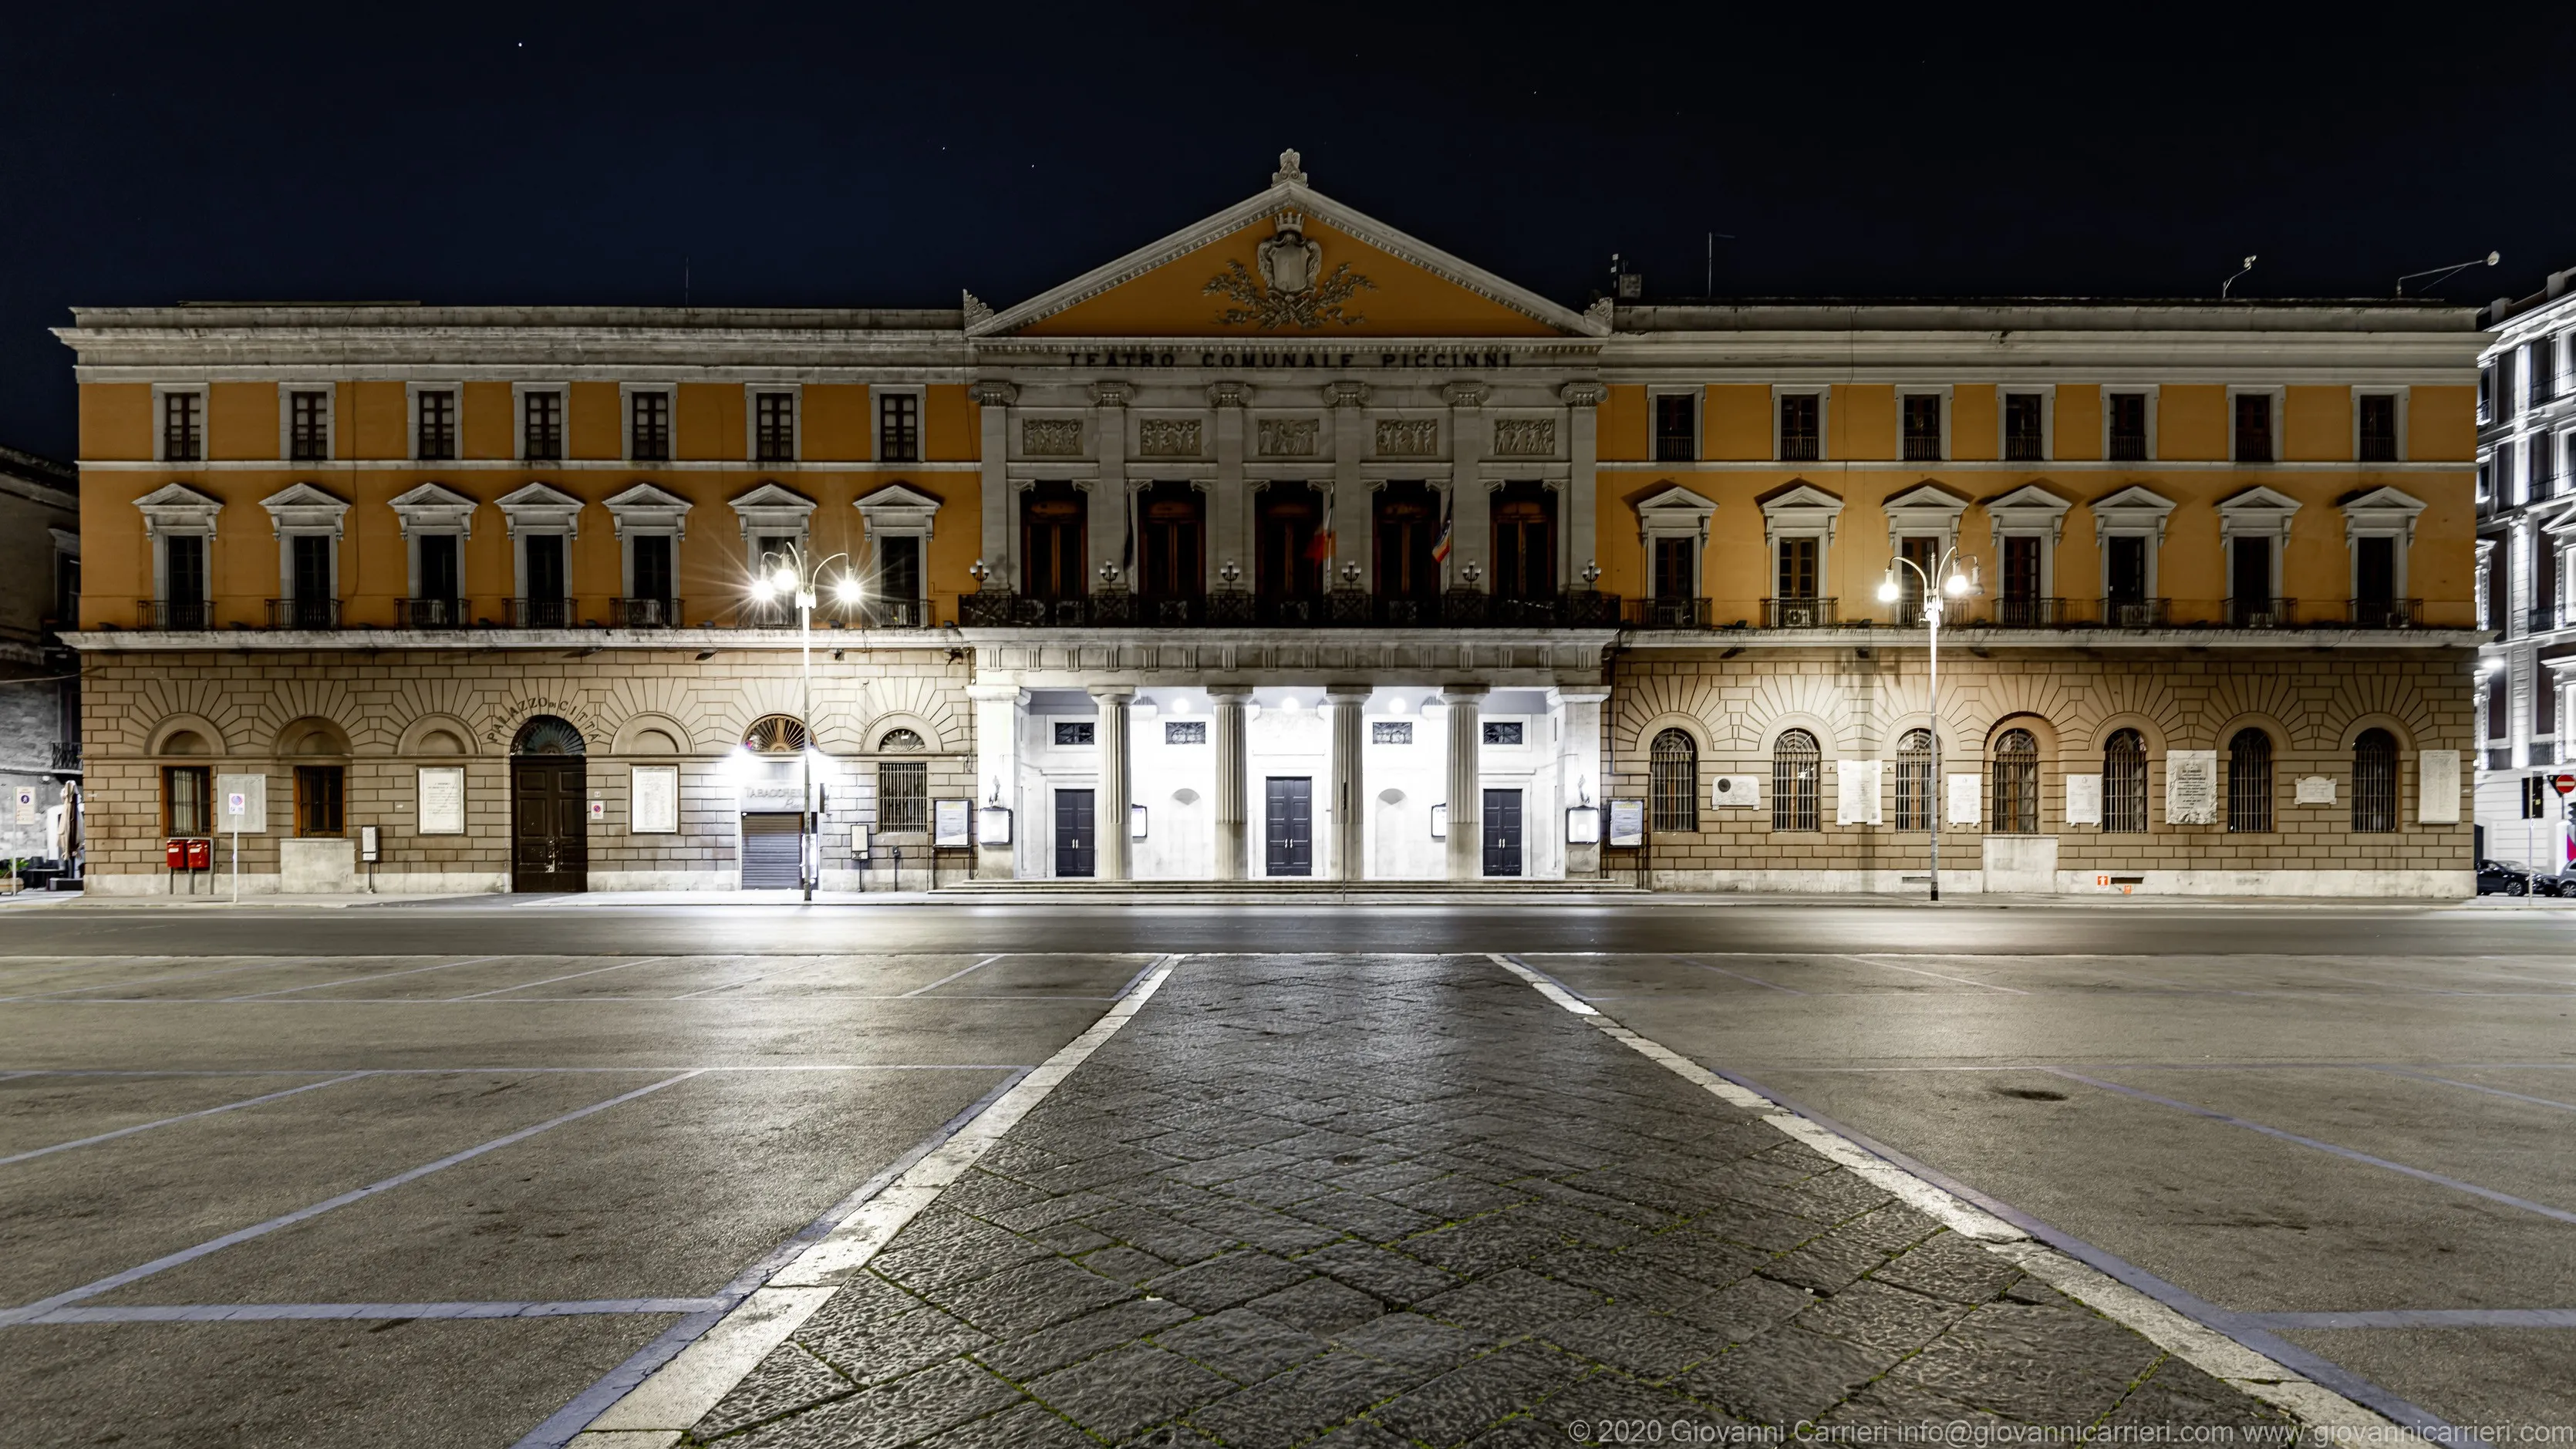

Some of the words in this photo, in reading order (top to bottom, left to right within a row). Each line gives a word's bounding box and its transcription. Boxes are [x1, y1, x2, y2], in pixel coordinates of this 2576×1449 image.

[1067, 352, 1175, 368] TEATRO
[1202, 352, 1354, 368] COMUNALE
[1381, 352, 1512, 368] PICCINNI
[487, 696, 548, 743] PALAZZO
